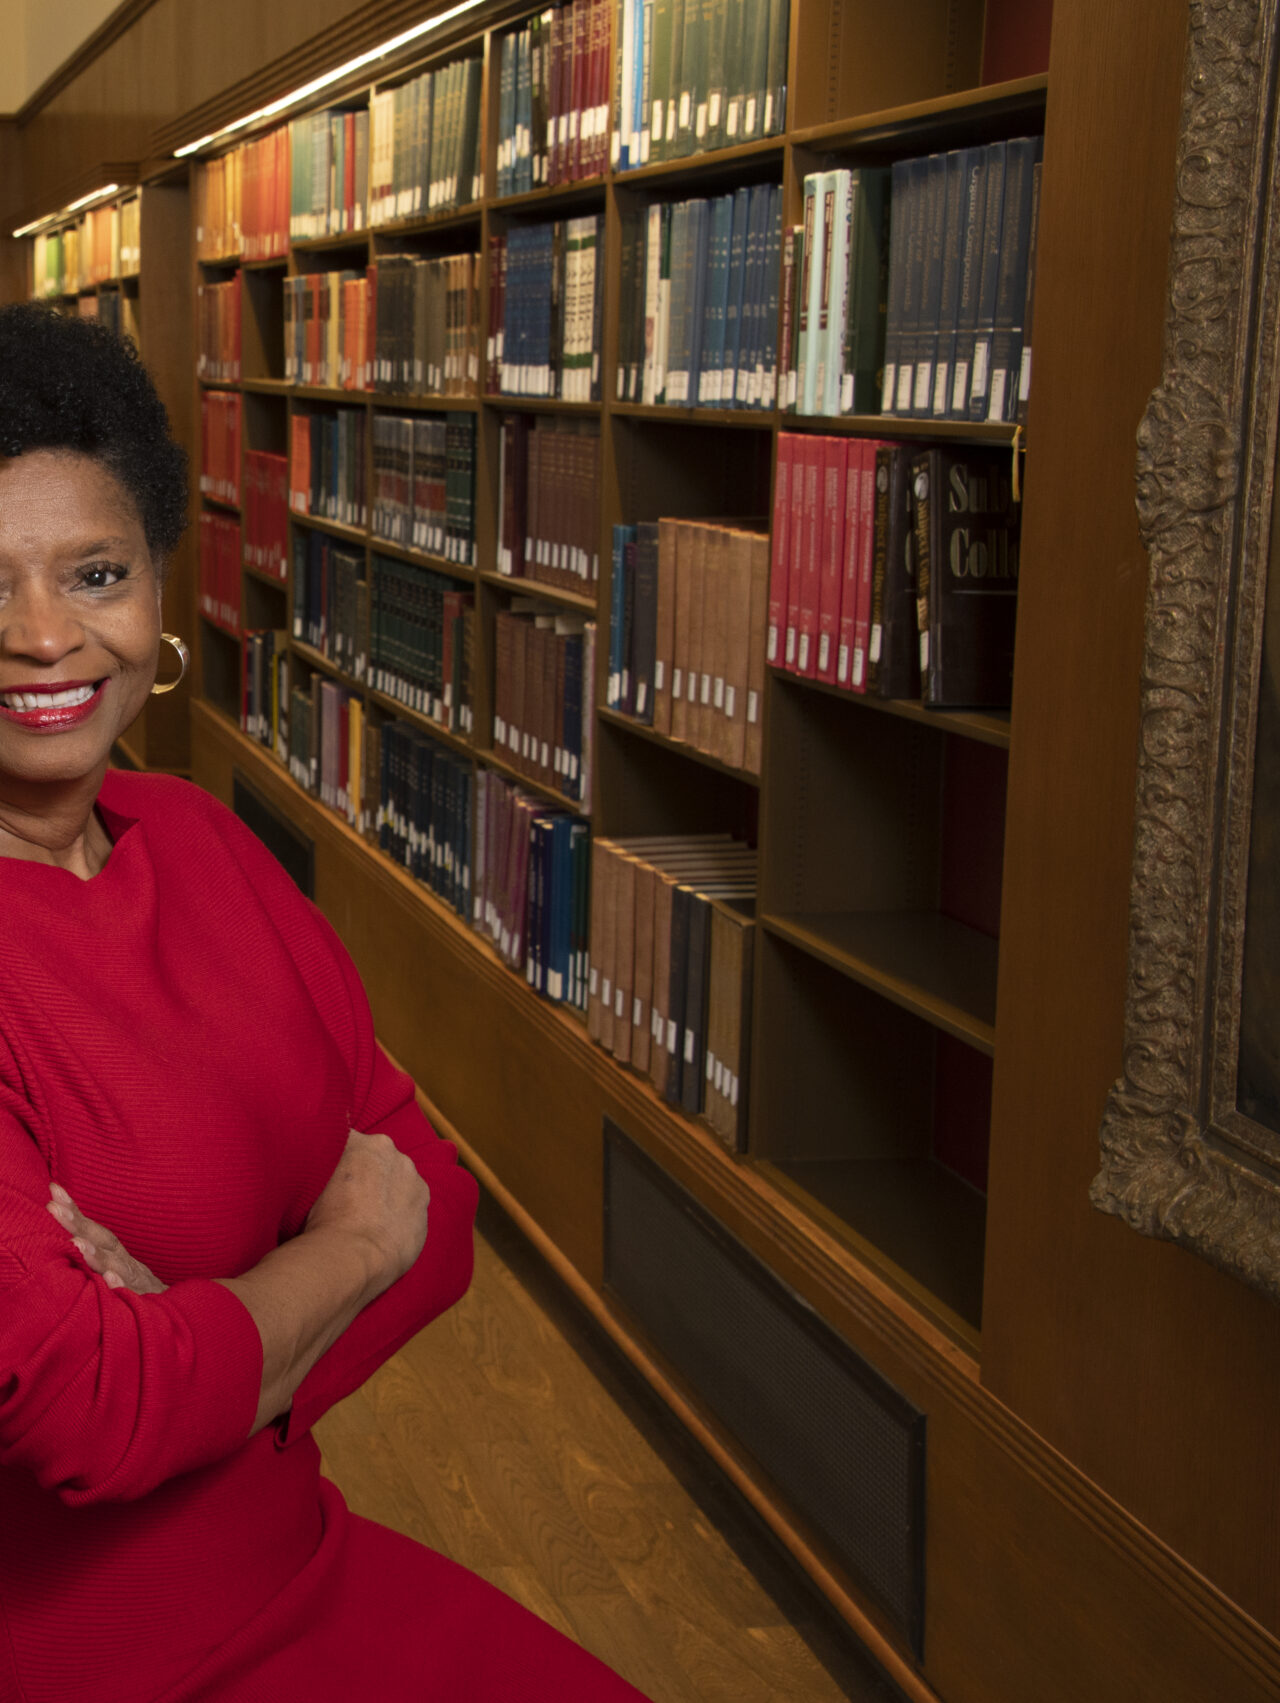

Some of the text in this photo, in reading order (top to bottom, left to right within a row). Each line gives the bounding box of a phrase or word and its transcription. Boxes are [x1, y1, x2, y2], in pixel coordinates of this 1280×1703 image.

[962, 166, 979, 308] Organic Compounds
[875, 495, 888, 550] Subject
[915, 501, 930, 556] Subject
